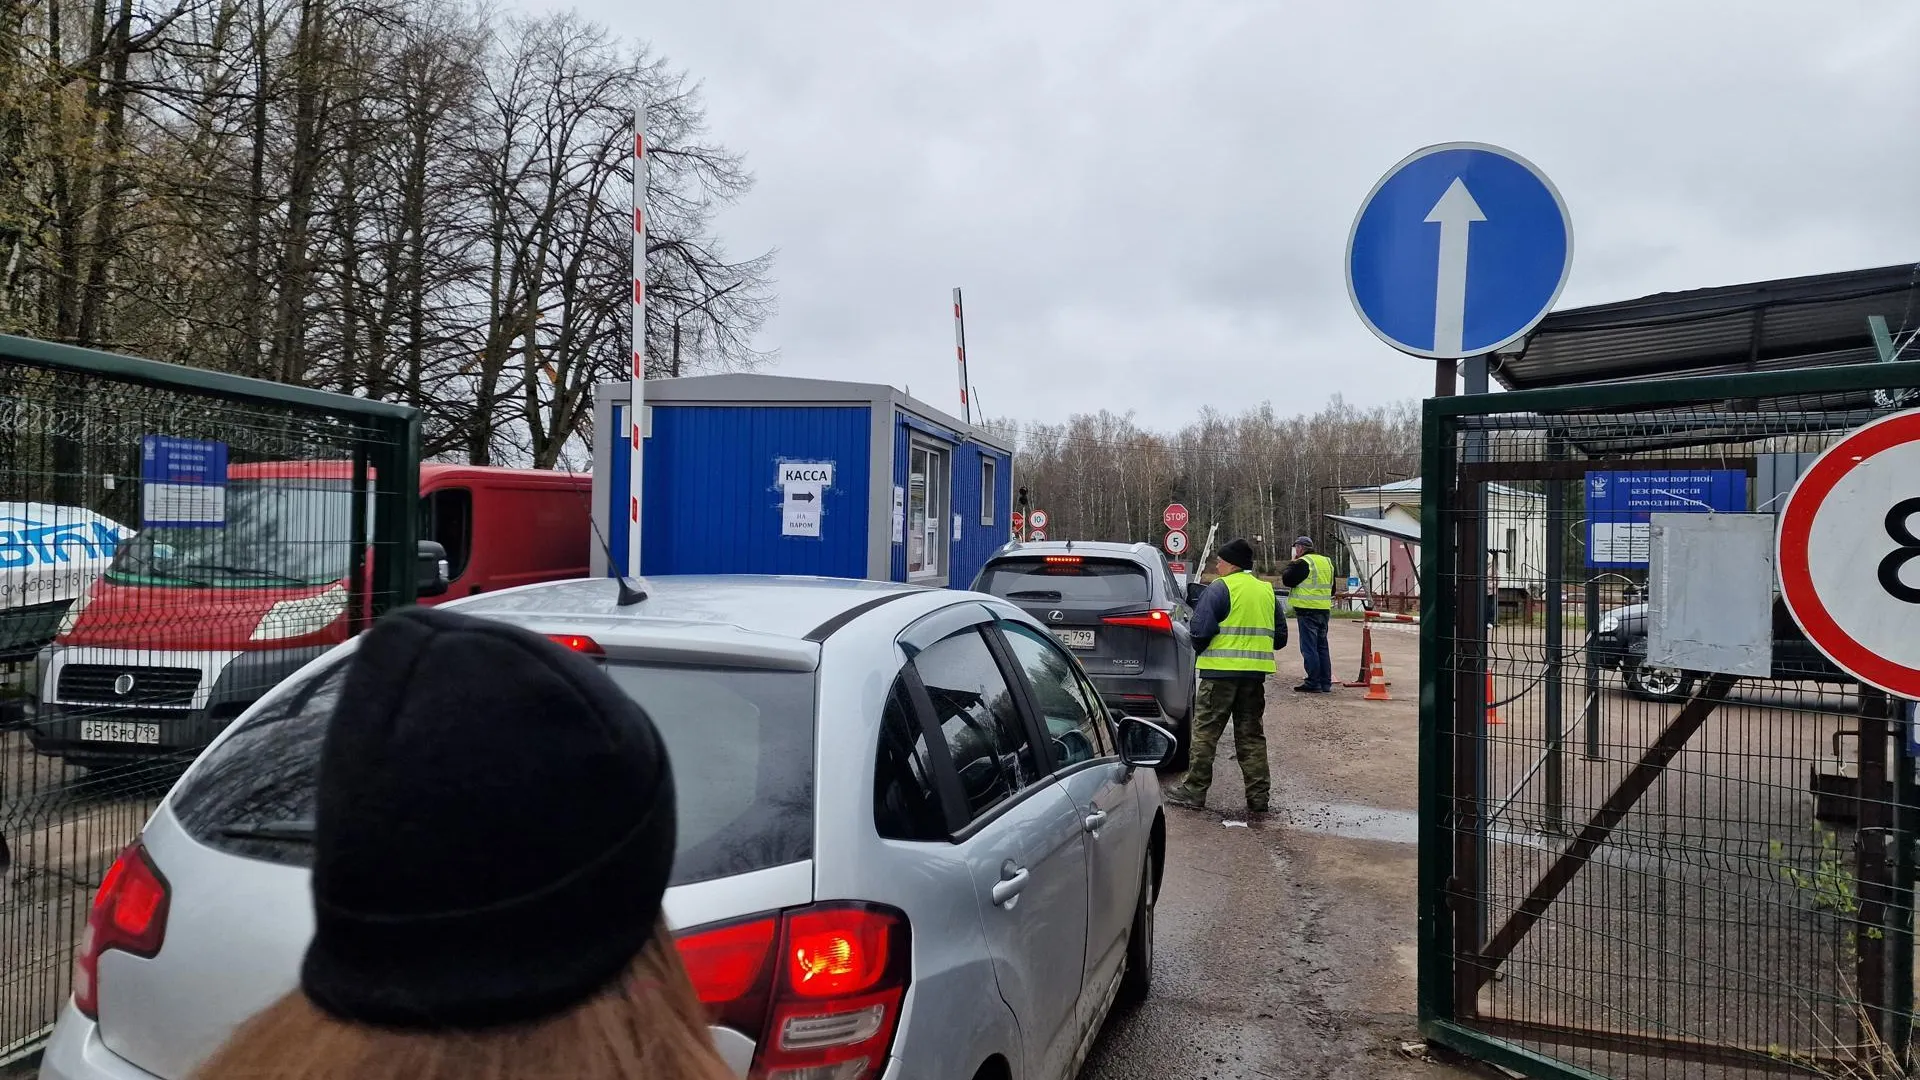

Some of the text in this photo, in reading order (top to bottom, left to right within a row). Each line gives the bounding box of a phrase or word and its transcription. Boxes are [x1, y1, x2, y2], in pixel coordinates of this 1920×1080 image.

[785, 470, 828, 481] КАССА
[1618, 476, 1641, 484] ЗОНА
[1165, 512, 1187, 521] STOP
[789, 522, 814, 530] ПАРОМ
[1172, 537, 1180, 547] 5
[1073, 631, 1092, 641] 799
